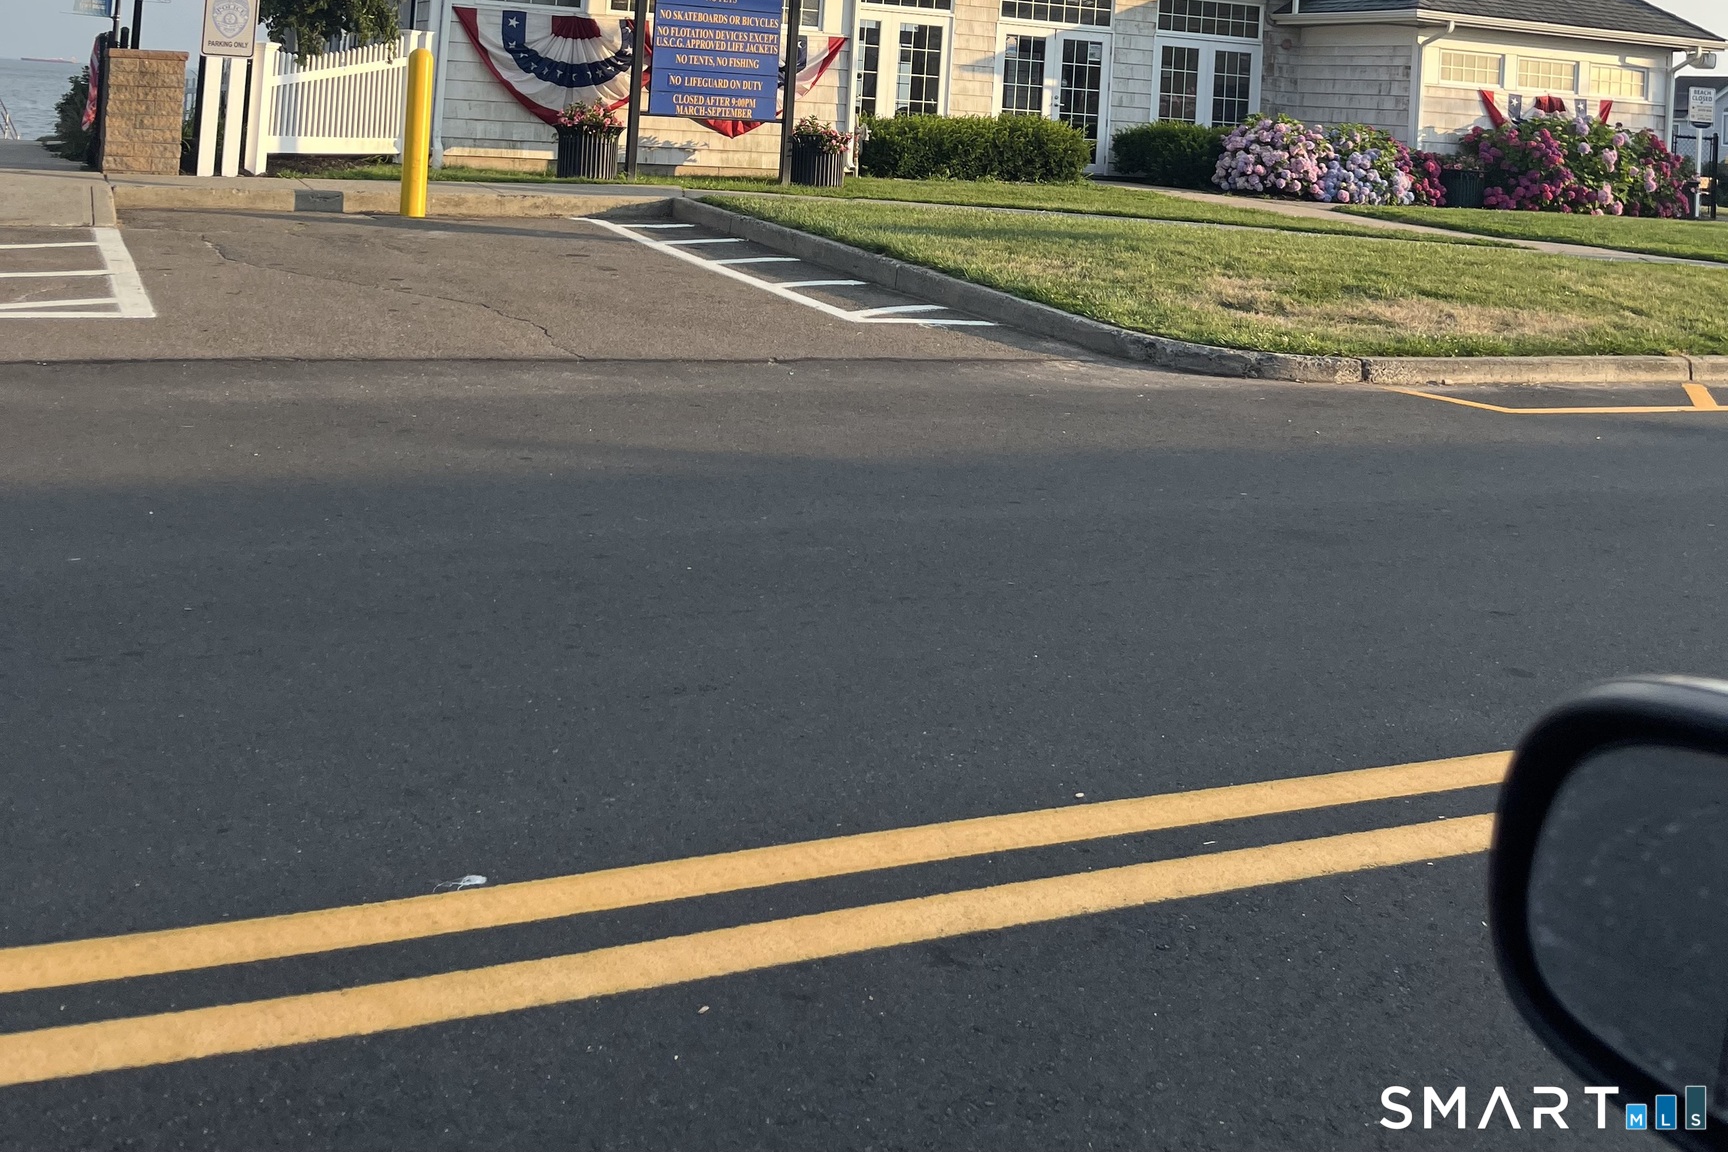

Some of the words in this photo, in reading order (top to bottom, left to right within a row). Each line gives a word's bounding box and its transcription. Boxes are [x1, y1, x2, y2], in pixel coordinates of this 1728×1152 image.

[660, 9, 672, 19] NO
[672, 11, 728, 25] SKATEBOARDS
[729, 15, 741, 25] OR
[741, 16, 779, 28] BICYCLES
[657, 26, 669, 36] NO
[670, 27, 714, 39] FLOTATION
[715, 30, 749, 42] DEVICES
[749, 32, 778, 44] EXCEPT
[208, 40, 233, 48] PARKING
[233, 41, 249, 49] ONLY
[656, 37, 685, 48] U.S.C.G.
[685, 39, 727, 52] APPROVED
[727, 42, 745, 52] LIFE
[745, 44, 778, 55] JACKETS
[675, 54, 687, 64] NO
[688, 55, 715, 67] TENTS,
[716, 56, 728, 67] NO
[729, 58, 760, 69] FISHING
[669, 75, 682, 86] NO
[684, 76, 729, 89] LIFEGUARD
[729, 79, 742, 90] ON
[742, 80, 763, 91] DUTY
[672, 94, 704, 105] CLOSED
[705, 95, 730, 107] AFTER
[731, 97, 756, 109] 9:00PM
[675, 105, 752, 119] MARCH-SEPTEMBER
